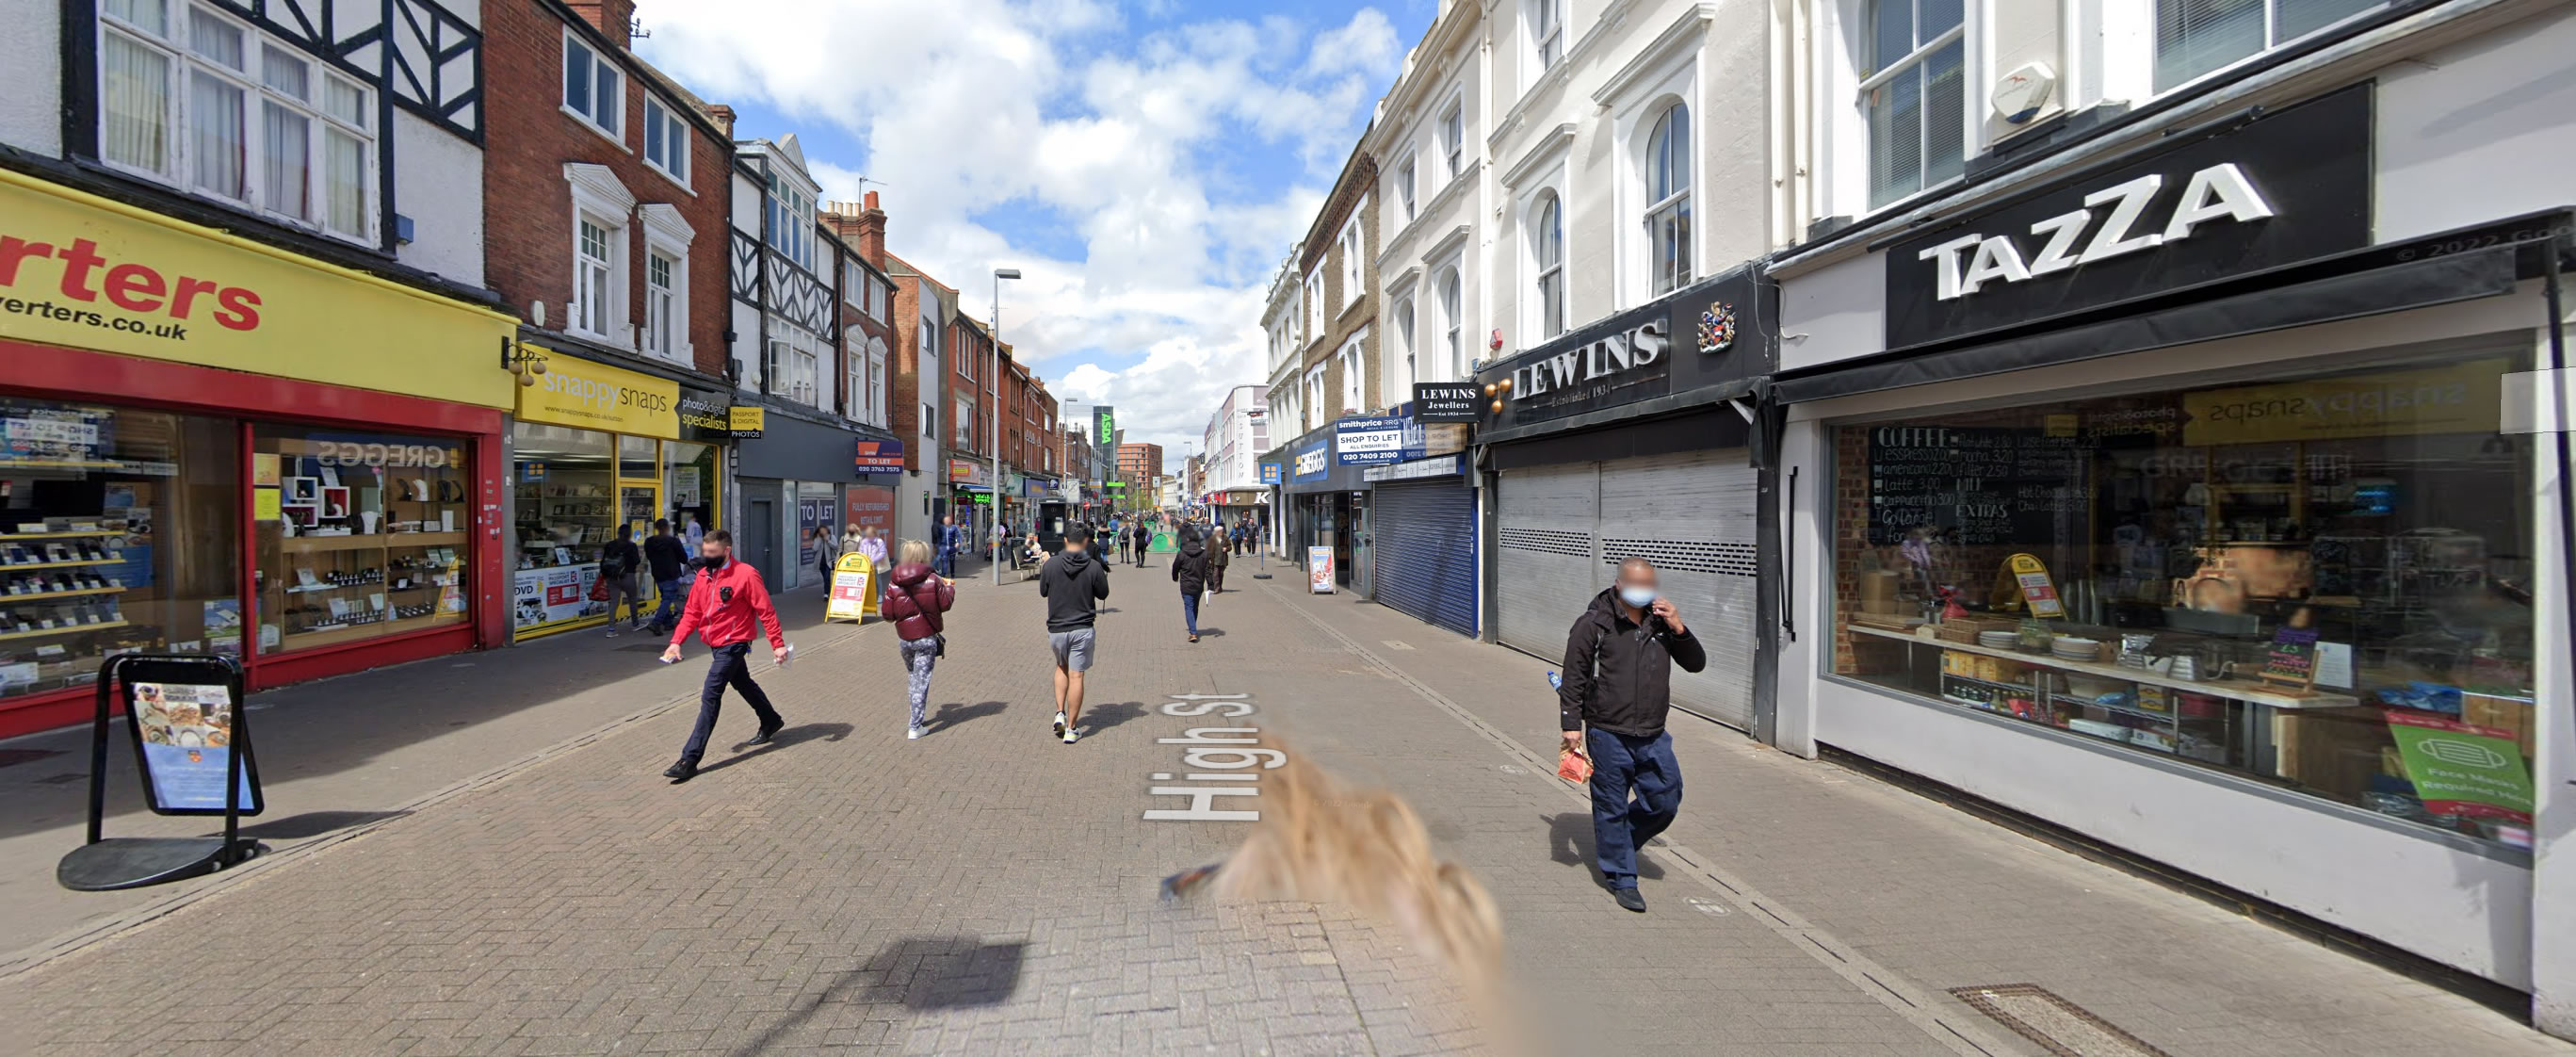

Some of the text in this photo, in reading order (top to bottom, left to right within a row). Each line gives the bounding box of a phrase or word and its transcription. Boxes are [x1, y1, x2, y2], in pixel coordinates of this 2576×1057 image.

[1919, 162, 2276, 301] TAZZA
[1512, 318, 1668, 400] LEWINS
[543, 370, 667, 416] snappy snaps
[1421, 388, 1476, 399] LEWINS
[682, 413, 726, 431] specialists
[1101, 413, 1111, 445] ASDA
[1338, 419, 1382, 429] smithprice
[1878, 427, 1951, 447] COFFEE
[1300, 447, 1326, 475] GREGGS
[801, 505, 834, 521] TO LET
[1956, 504, 2008, 518] EXTRAS
[585, 572, 598, 580] FIL
[514, 585, 533, 596] DVD
[2427, 768, 2466, 779] Face
[2422, 780, 2495, 796] Required
